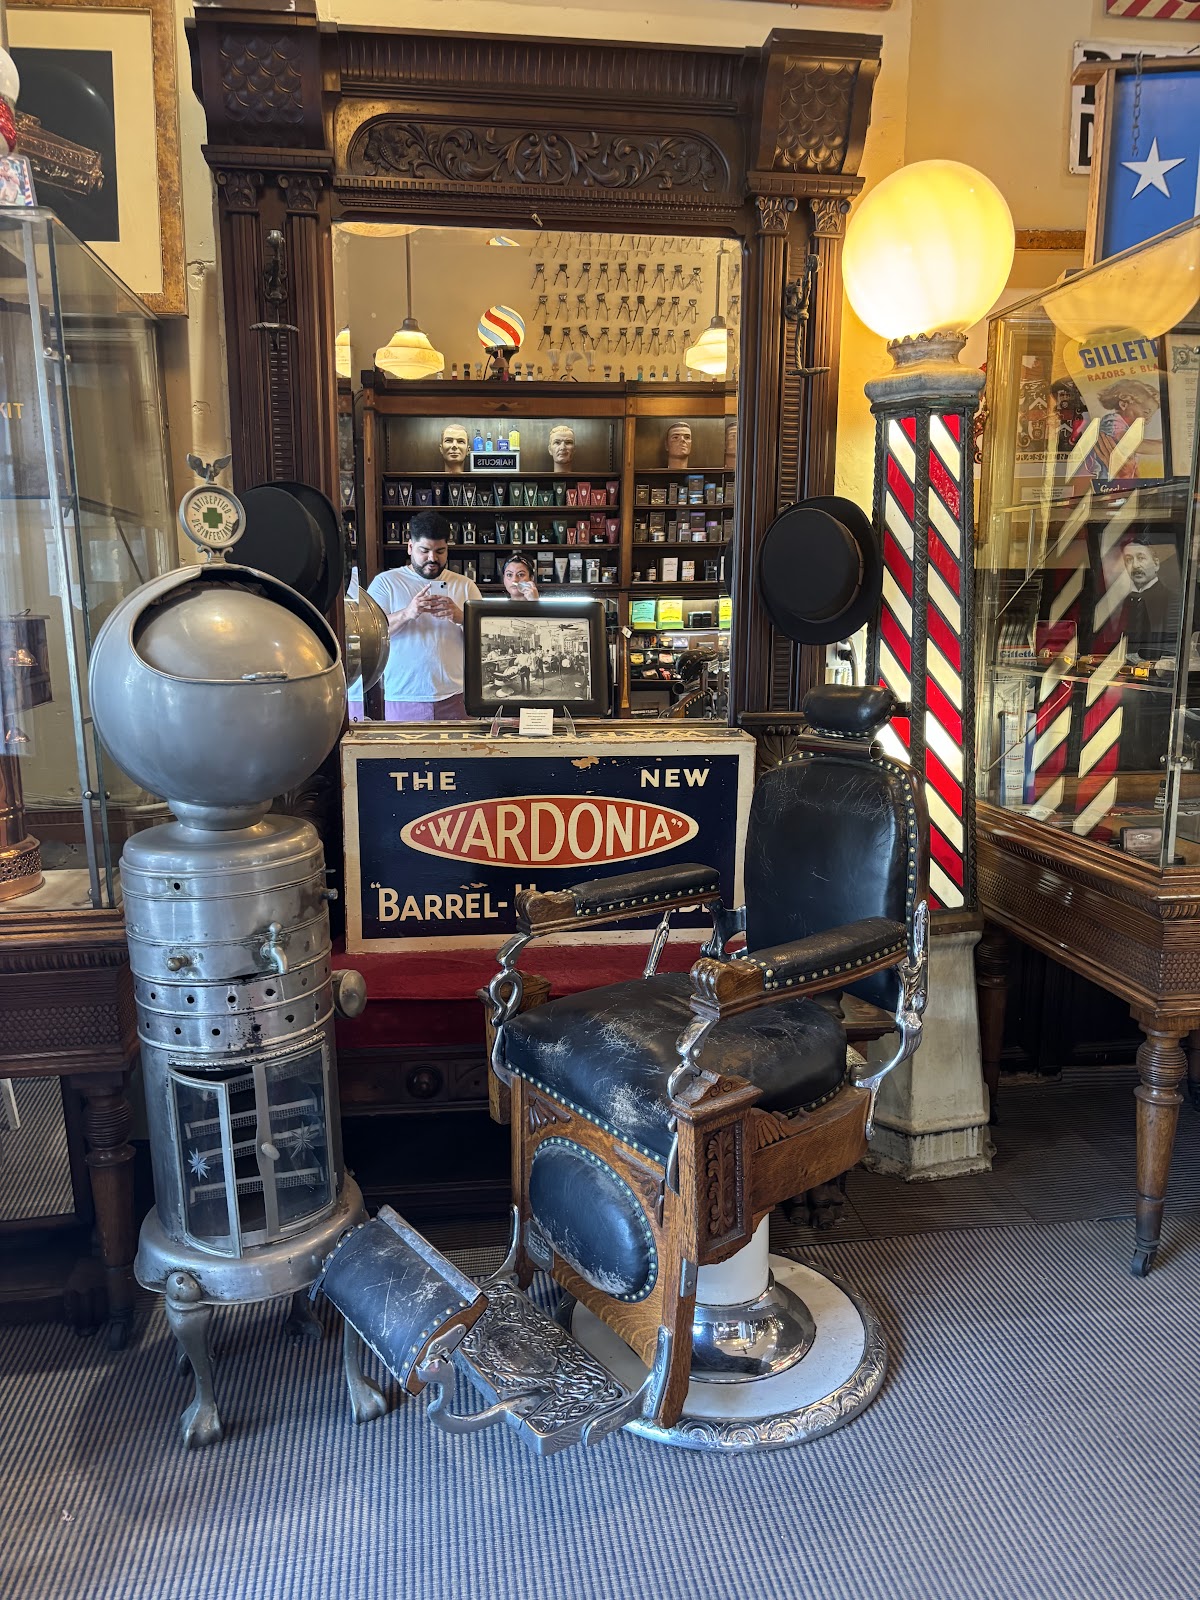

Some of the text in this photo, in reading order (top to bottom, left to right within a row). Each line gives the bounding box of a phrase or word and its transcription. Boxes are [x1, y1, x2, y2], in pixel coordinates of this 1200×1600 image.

[1079, 339, 1159, 369] GILLETT
[1087, 368, 1126, 382] RAZORS
[1140, 363, 1159, 373] BLA
[192, 495, 232, 514] ANTISEPTICO
[192, 519, 233, 540] DESINFECTANTE
[389, 768, 710, 791] THE NEW
[415, 801, 684, 862] “WARDONIA”
